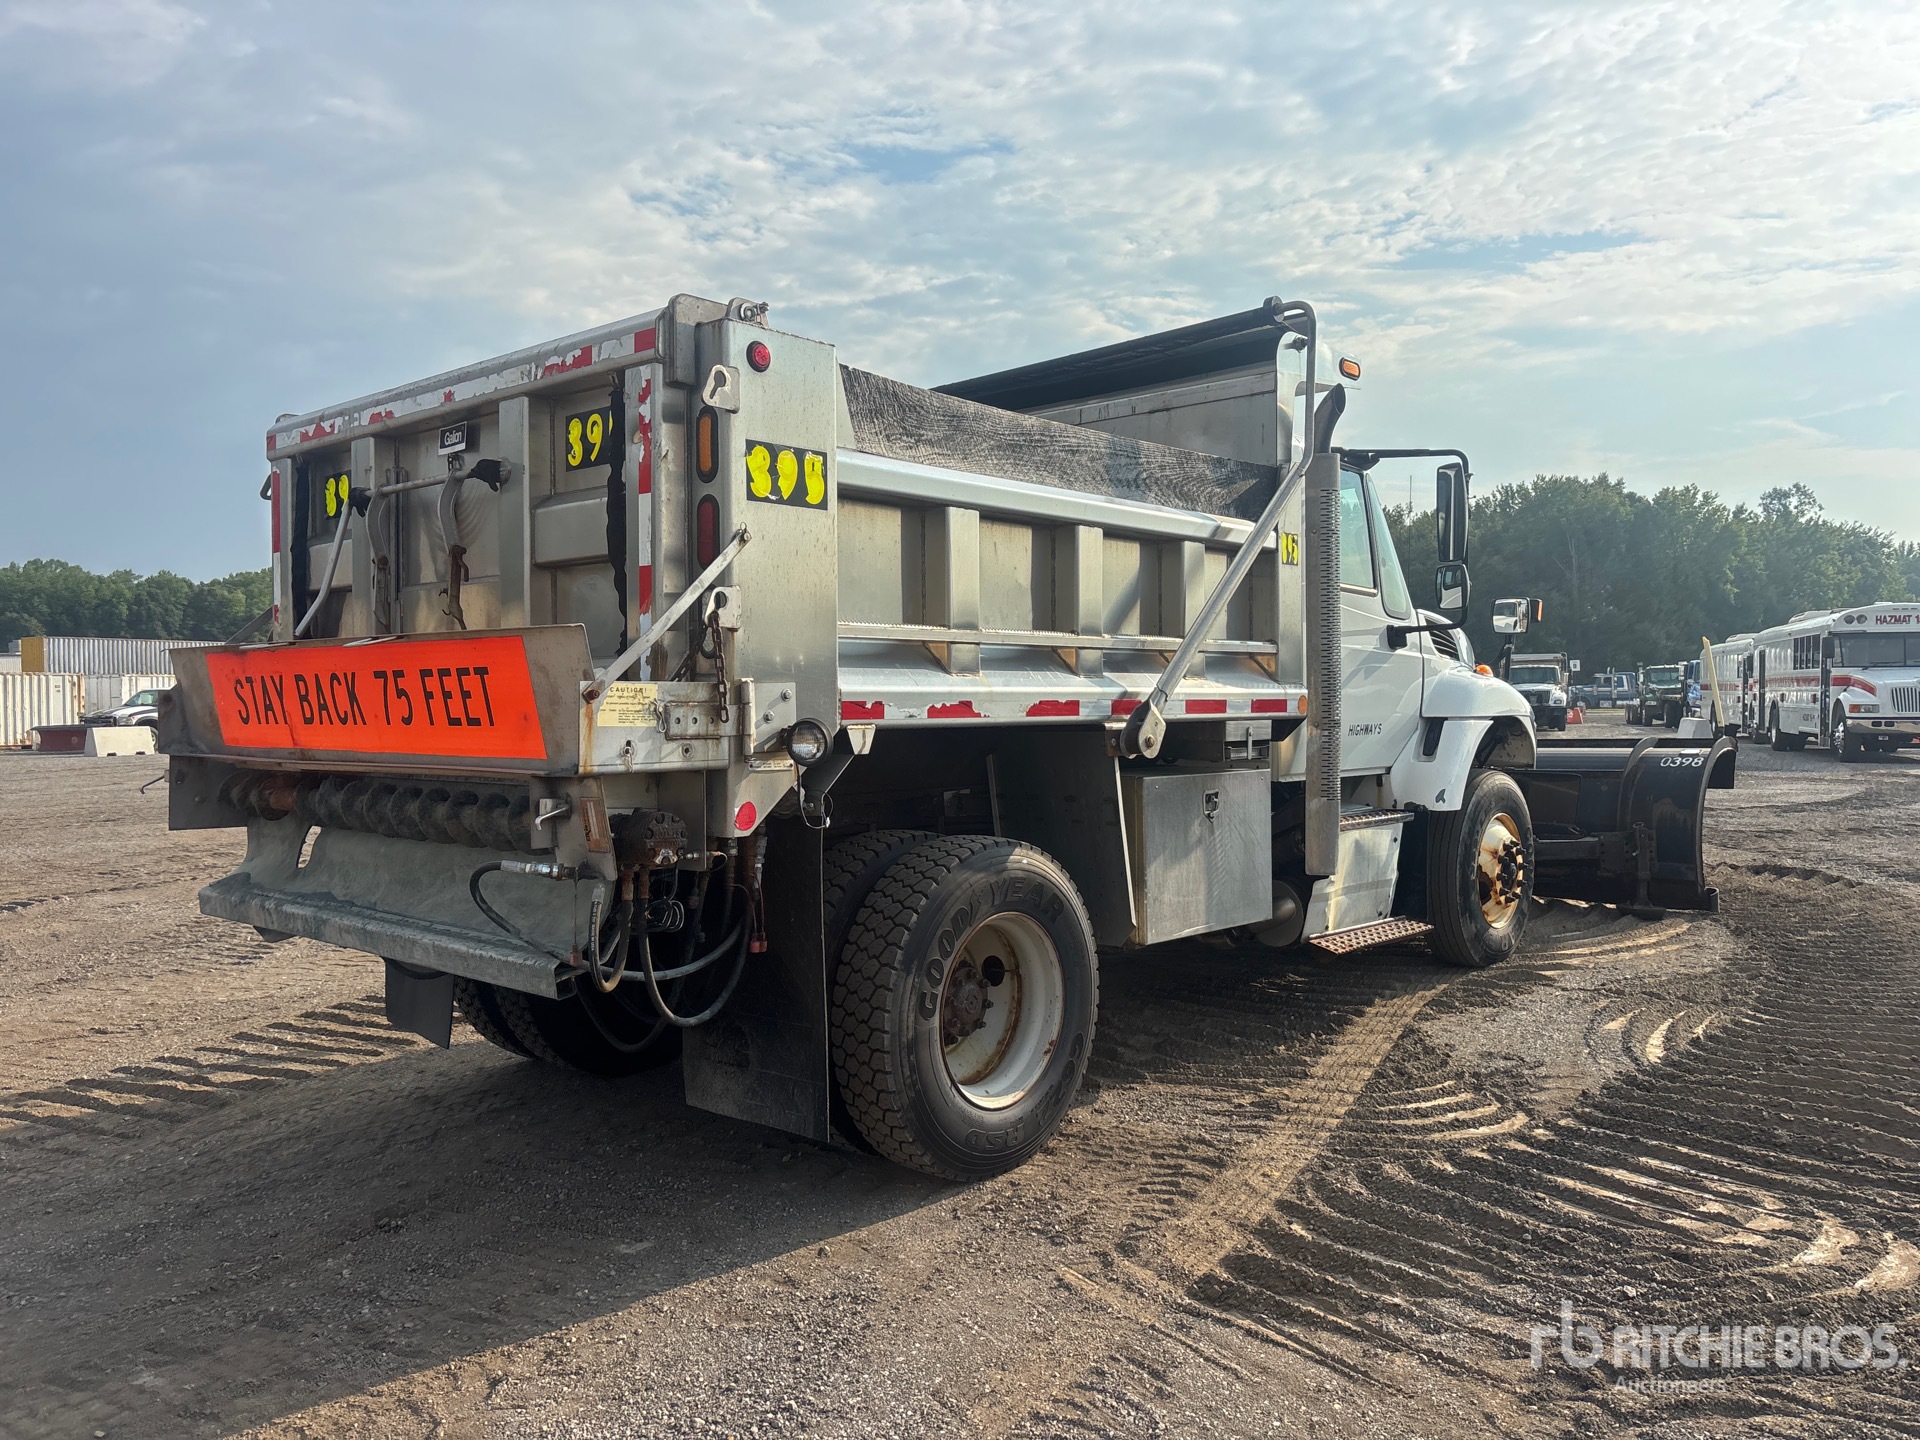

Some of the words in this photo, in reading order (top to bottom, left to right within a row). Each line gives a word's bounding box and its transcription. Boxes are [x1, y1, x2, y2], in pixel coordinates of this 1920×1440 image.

[567, 412, 614, 467] 39
[1875, 614, 1912, 625] HAZMAT
[234, 675, 289, 725] STAY
[295, 672, 367, 726] BACK
[373, 669, 414, 726] 75
[419, 666, 495, 727] FEET
[1347, 723, 1382, 736] HIGHWAYS
[1660, 756, 1704, 767] 0398
